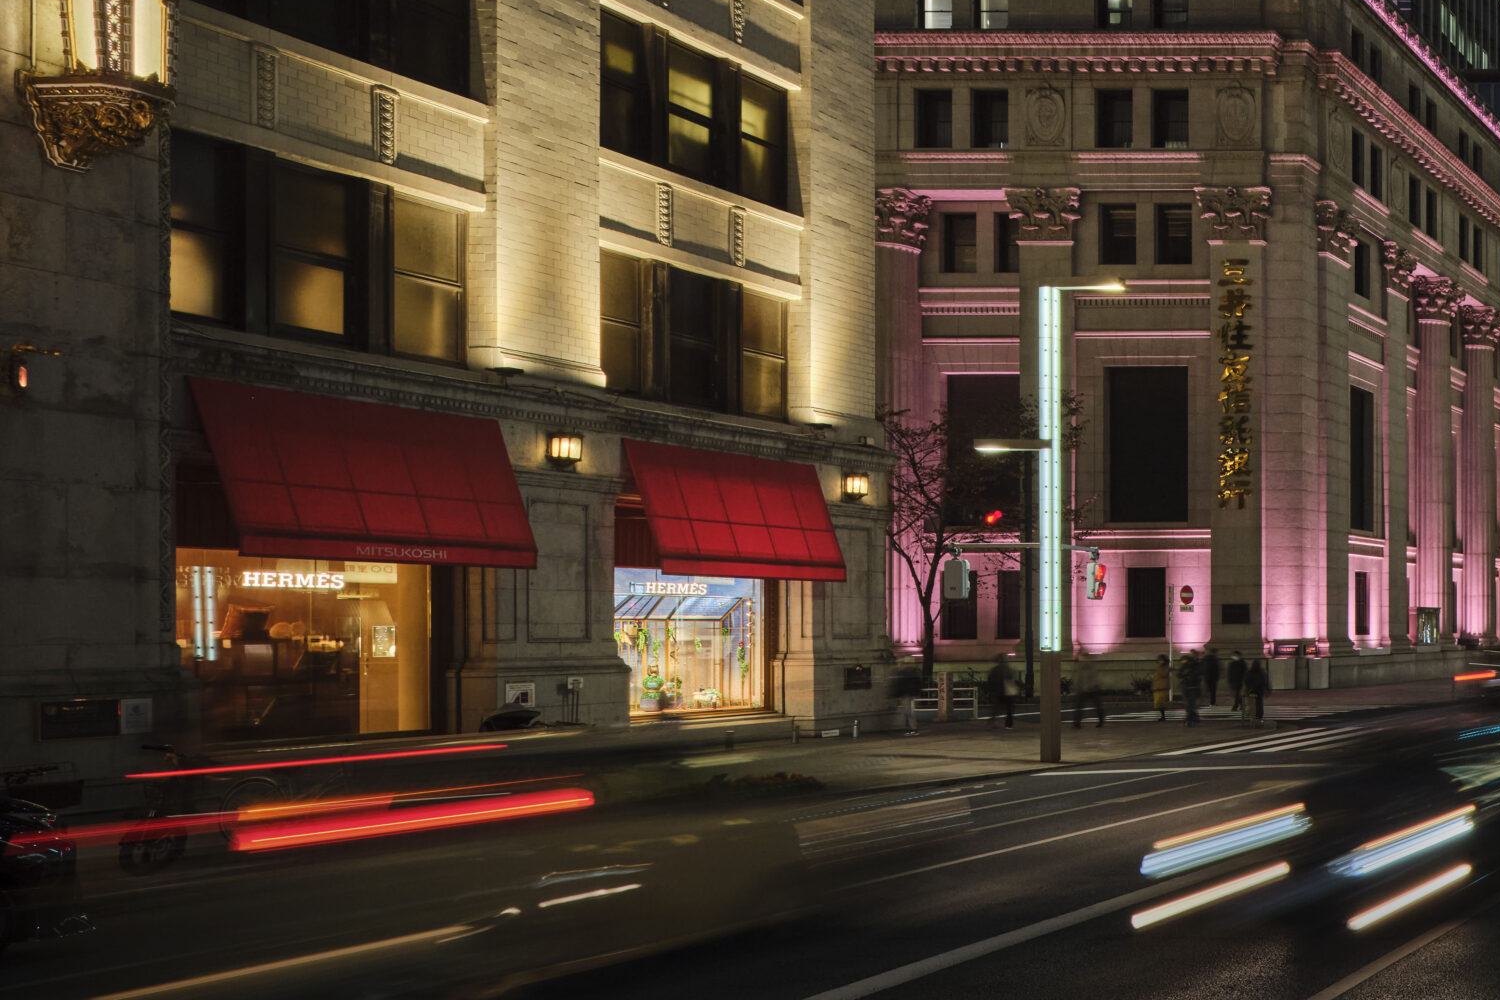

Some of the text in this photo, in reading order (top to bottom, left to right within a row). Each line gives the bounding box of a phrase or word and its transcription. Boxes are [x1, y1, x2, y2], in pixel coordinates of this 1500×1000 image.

[1217, 258, 1254, 510] 三井住友信託銀行
[355, 545, 447, 560] MITSUKOSHI
